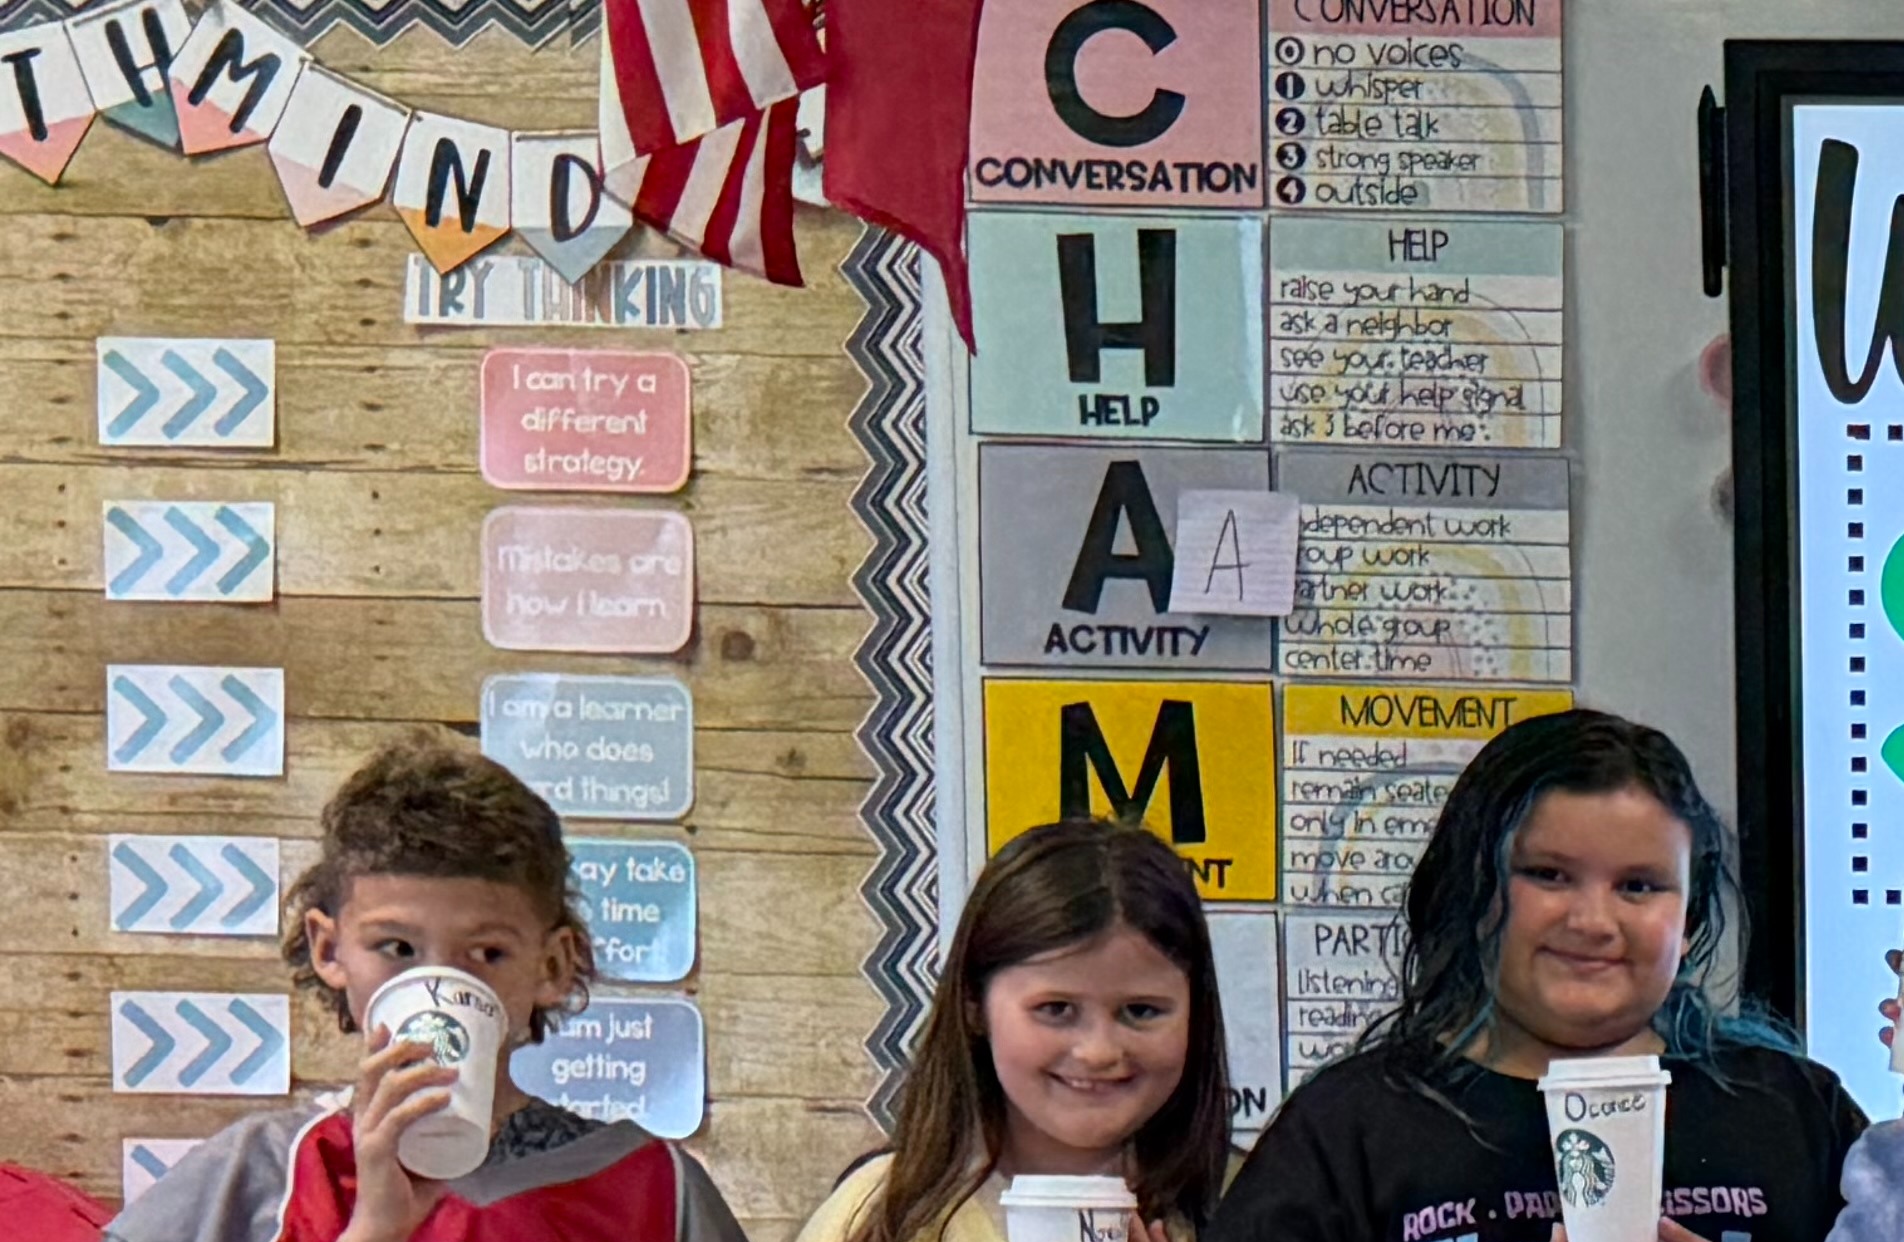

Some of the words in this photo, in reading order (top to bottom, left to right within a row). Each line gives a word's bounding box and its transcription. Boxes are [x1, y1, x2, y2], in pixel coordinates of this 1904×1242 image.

[1296, 0, 1536, 27] CONVERSATION
[1314, 43, 1355, 66] no
[1366, 38, 1465, 69] voices
[1045, 0, 1186, 148] C
[1315, 72, 1424, 105] whisper
[1315, 110, 1383, 141] table
[1395, 112, 1440, 141] talk
[1317, 144, 1391, 176] strong
[1398, 150, 1483, 176] speaker
[976, 157, 1257, 195] CONVERSATION
[1314, 178, 1419, 206] outside
[1388, 228, 1449, 263] HELP
[414, 257, 495, 319] TRY
[517, 260, 717, 327] THINKING
[1280, 275, 1335, 301] raise
[1343, 282, 1398, 305] your
[1409, 276, 1469, 304] hand
[1056, 228, 1178, 387] H
[1280, 311, 1315, 334] ask
[1324, 316, 1339, 333] a
[1346, 308, 1453, 341] neighbor
[1280, 346, 1324, 370] see
[1400, 346, 1490, 372] teacher
[526, 372, 576, 391] can
[581, 367, 629, 396] try
[637, 373, 658, 394] a
[1280, 382, 1327, 404] use
[1334, 385, 1391, 410] your
[1401, 381, 1455, 407] help
[521, 409, 648, 436] different
[1080, 394, 1160, 427] HELP
[1280, 415, 1315, 438] ask
[1343, 413, 1425, 440] before
[1348, 463, 1501, 497] ACTIVITY
[1062, 459, 1172, 615] A
[1300, 507, 1435, 540] dependent
[1445, 514, 1511, 539] work
[499, 547, 623, 576] Mistakes
[630, 556, 682, 577] are
[1205, 509, 1250, 603] A
[1363, 546, 1430, 567] work
[506, 591, 568, 617] how
[1297, 580, 1368, 602] artner
[1381, 580, 1448, 602] work
[1044, 622, 1210, 657] ACTIVITY
[1382, 614, 1452, 642] group
[1285, 649, 1361, 671] center
[1375, 647, 1432, 672] time
[502, 699, 549, 721] am
[554, 699, 573, 720] a
[579, 695, 687, 722] learner
[1341, 695, 1518, 730] MOVEMENT
[519, 737, 578, 761] who
[586, 737, 655, 763] does
[1293, 740, 1310, 765] If
[1319, 741, 1407, 768] needed
[1059, 700, 1206, 844] M
[581, 780, 671, 809] things!
[1292, 776, 1376, 801] remain
[1385, 776, 1451, 804] seate
[1290, 810, 1345, 839] only
[1353, 810, 1376, 834] in
[627, 857, 686, 883] take
[1290, 850, 1366, 870] move
[1290, 878, 1372, 904] when
[602, 900, 661, 924] time
[607, 1012, 654, 1044] just
[551, 1051, 647, 1085] getting
